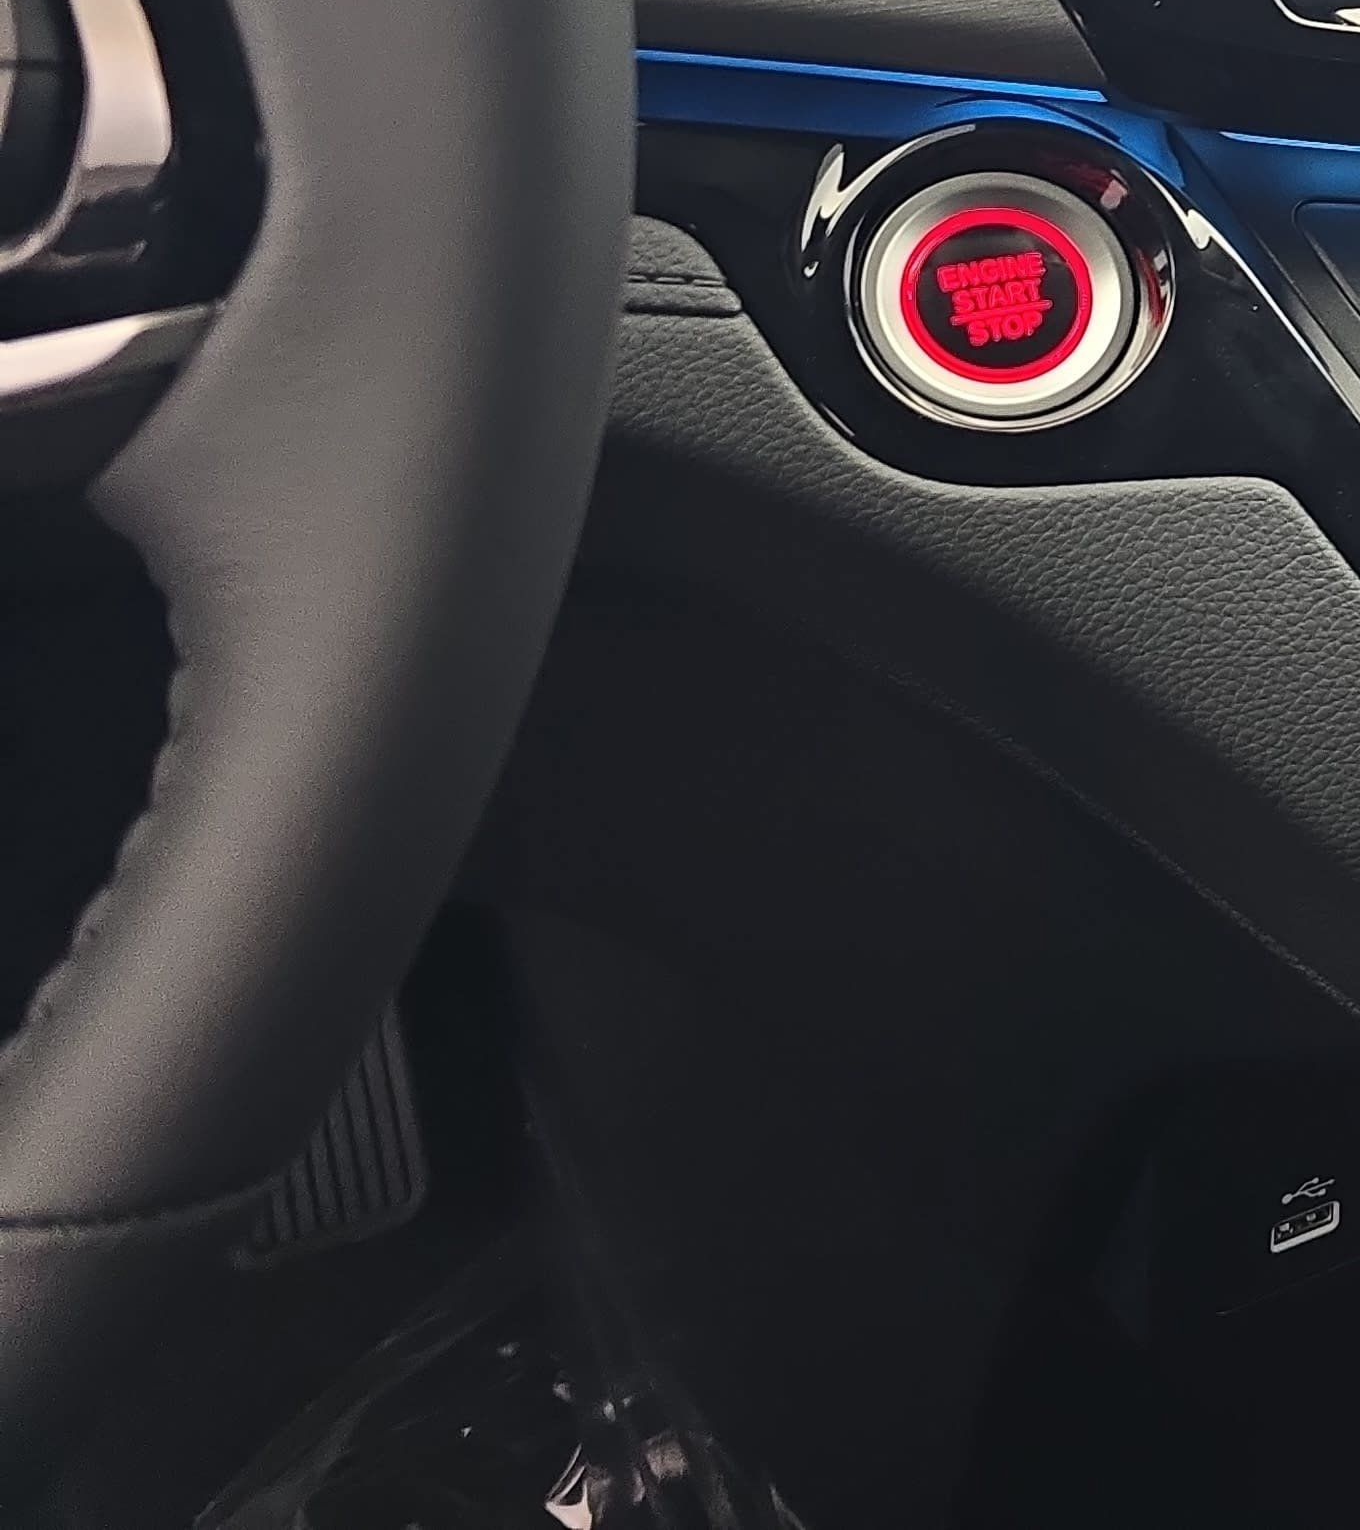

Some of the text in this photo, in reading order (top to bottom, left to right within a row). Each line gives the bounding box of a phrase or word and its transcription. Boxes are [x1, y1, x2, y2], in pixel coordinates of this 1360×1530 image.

[936, 252, 1047, 293] ENGINE
[951, 277, 1043, 315] START
[967, 311, 1044, 348] STOP
